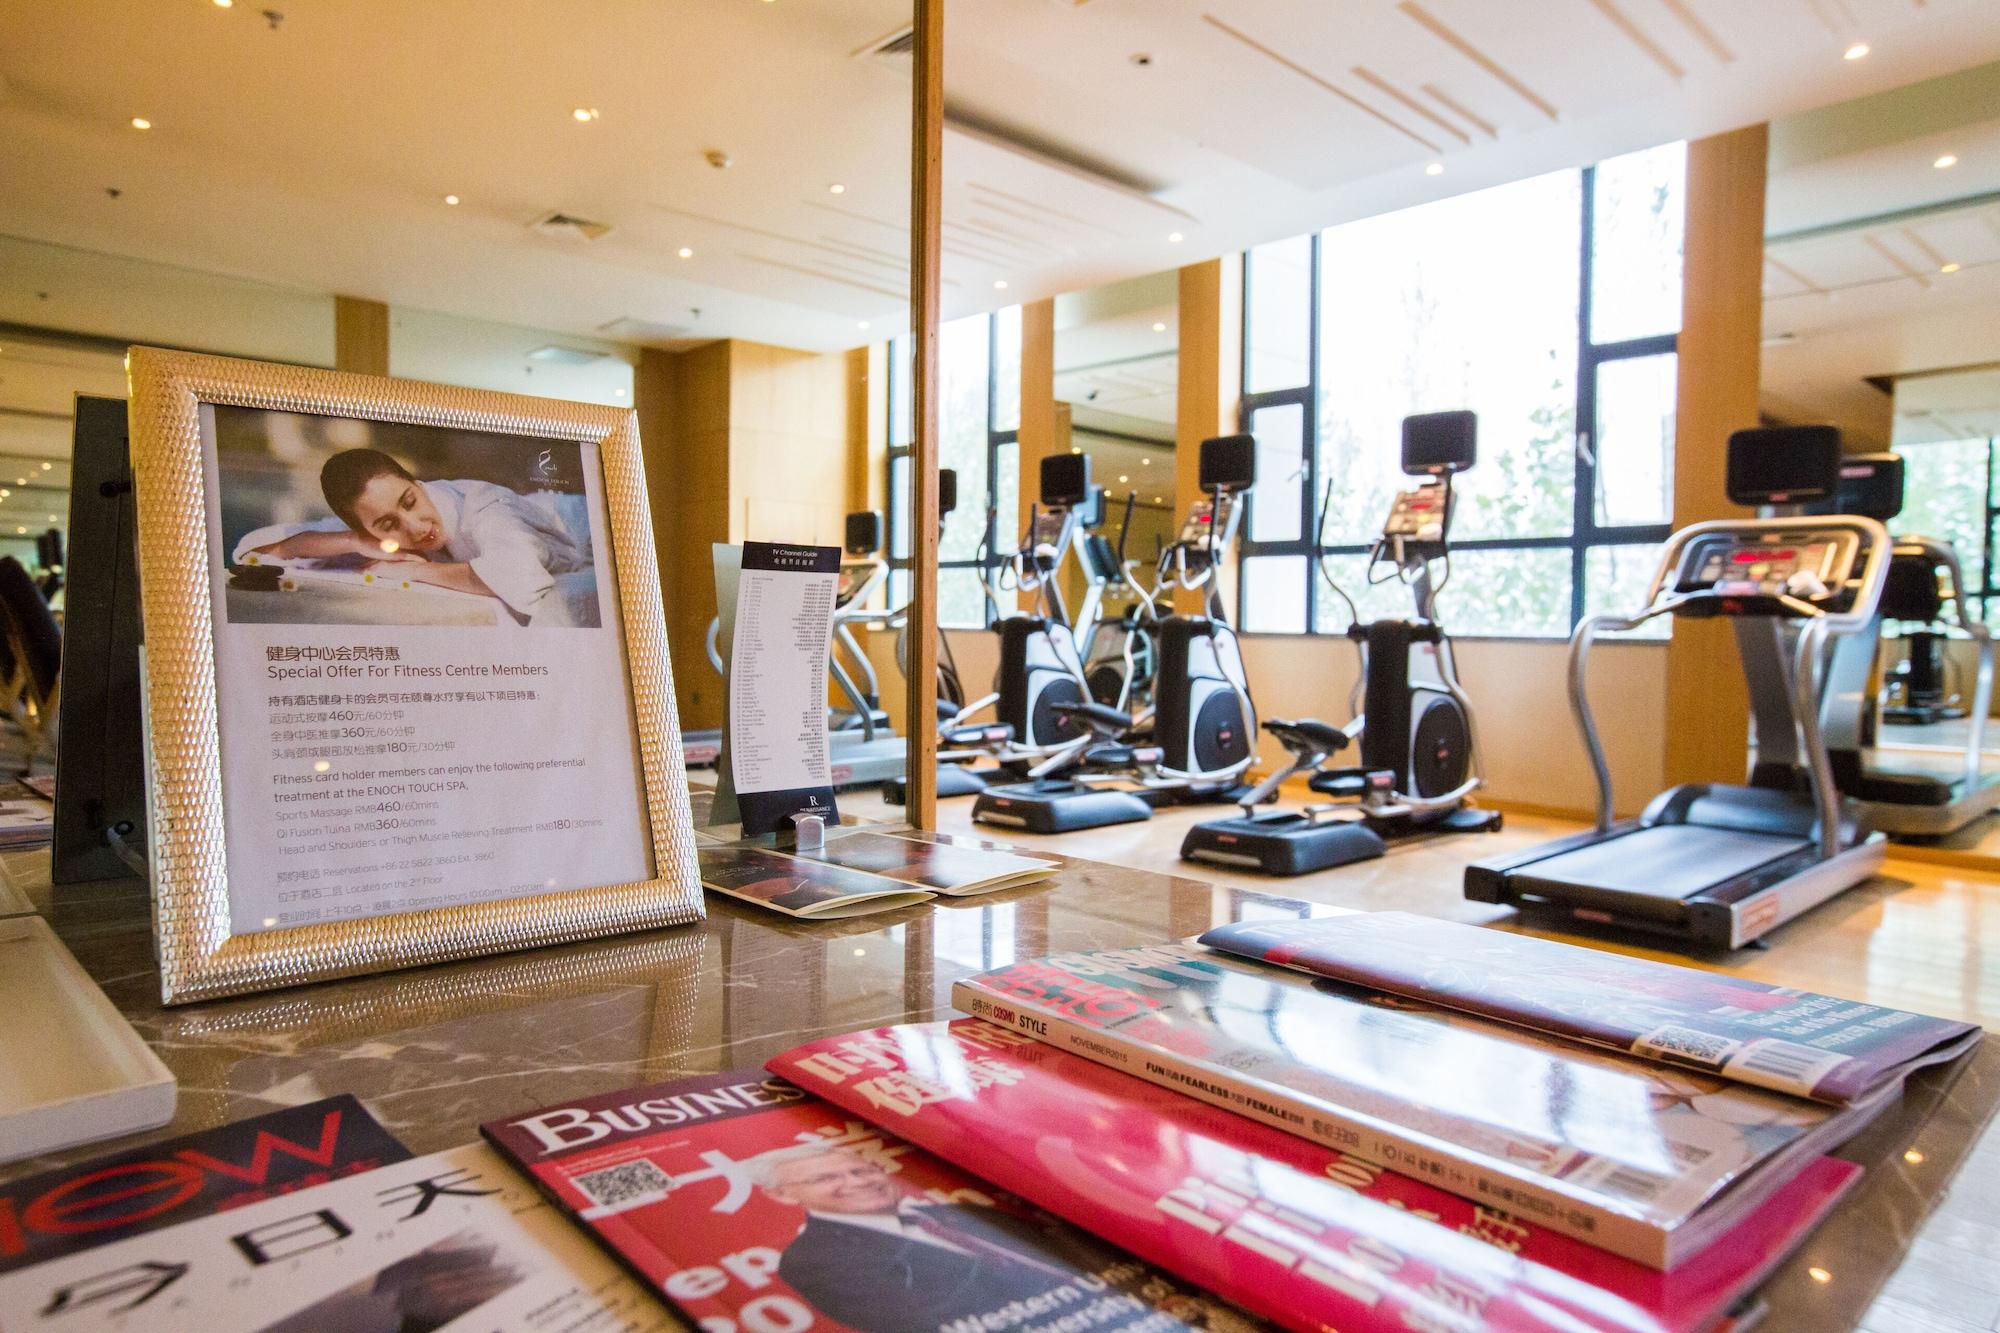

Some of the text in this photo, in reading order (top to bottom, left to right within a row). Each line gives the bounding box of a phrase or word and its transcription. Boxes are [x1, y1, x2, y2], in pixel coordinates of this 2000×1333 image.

[780, 549, 802, 557] Channel
[266, 645, 400, 662] 健身中心会员特惠
[268, 663, 549, 681] Special Offer For Fitness Centre Members
[273, 757, 586, 785] Fitness card holder members can enjoy the following preferential
[274, 789, 331, 803] treatment
[333, 788, 344, 799] at
[347, 786, 365, 798] the
[367, 784, 405, 797] ENOCH
[408, 782, 444, 794] TOUCH
[275, 810, 308, 823] Sports
[310, 806, 353, 820] Massage
[279, 844, 306, 856] Head
[307, 842, 326, 853] and
[329, 838, 377, 852] Shoulders
[391, 833, 418, 847] Thigh
[419, 831, 450, 843] Muscle
[491, 824, 534, 837] Treatment
[290, 827, 322, 839] Fusion
[323, 824, 351, 836] Tuina
[1019, 1014, 1048, 1036] STYLE
[1145, 1060, 1165, 1077] FUN
[1179, 1073, 1229, 1100] FEARLESS
[1245, 1096, 1288, 1120] FEMALE
